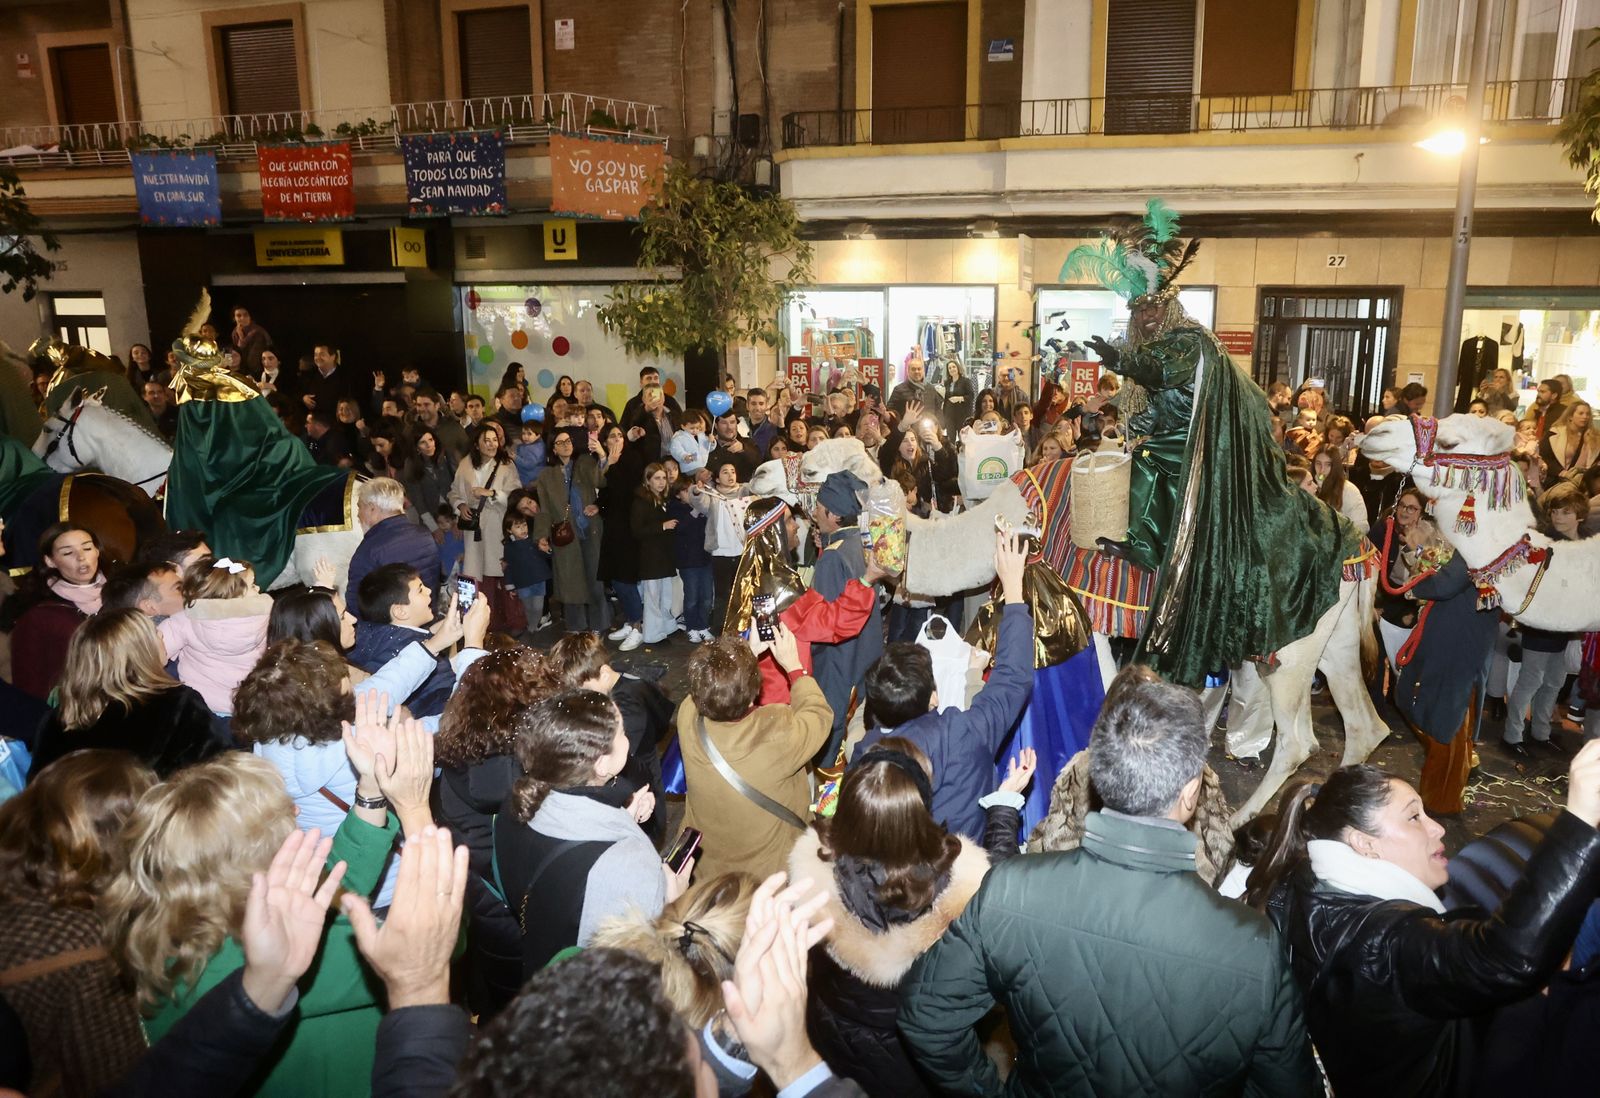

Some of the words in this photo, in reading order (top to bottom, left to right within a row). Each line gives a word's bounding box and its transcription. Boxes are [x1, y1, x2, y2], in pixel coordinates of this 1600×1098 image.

[427, 151, 452, 164] PARA
[456, 150, 477, 163] QUE
[268, 161, 286, 172] QUE
[288, 161, 320, 172] SUENEN
[321, 160, 339, 171] CON
[569, 158, 592, 176] YO
[596, 160, 626, 177] SOY
[629, 162, 647, 179] DE
[412, 167, 447, 182] TODOS
[449, 166, 468, 180] LOS
[470, 164, 494, 180] DÍAS
[294, 176, 310, 187] LOS
[311, 174, 349, 187] CÁNTICOS
[585, 177, 639, 195] GASPAR
[154, 191, 165, 203] EN
[187, 191, 205, 203] SUR
[280, 193, 291, 204] DE
[293, 192, 303, 203] MI
[304, 191, 331, 203] TIERRA
[420, 185, 446, 199] SEAN
[447, 184, 492, 198] NAVIDAD
[552, 228, 566, 246] U
[1328, 256, 1345, 267] 27
[791, 362, 808, 375] RE
[862, 364, 880, 377] RE
[1076, 368, 1095, 381] RE
[790, 375, 809, 387] BA
[1074, 381, 1095, 394] BA
